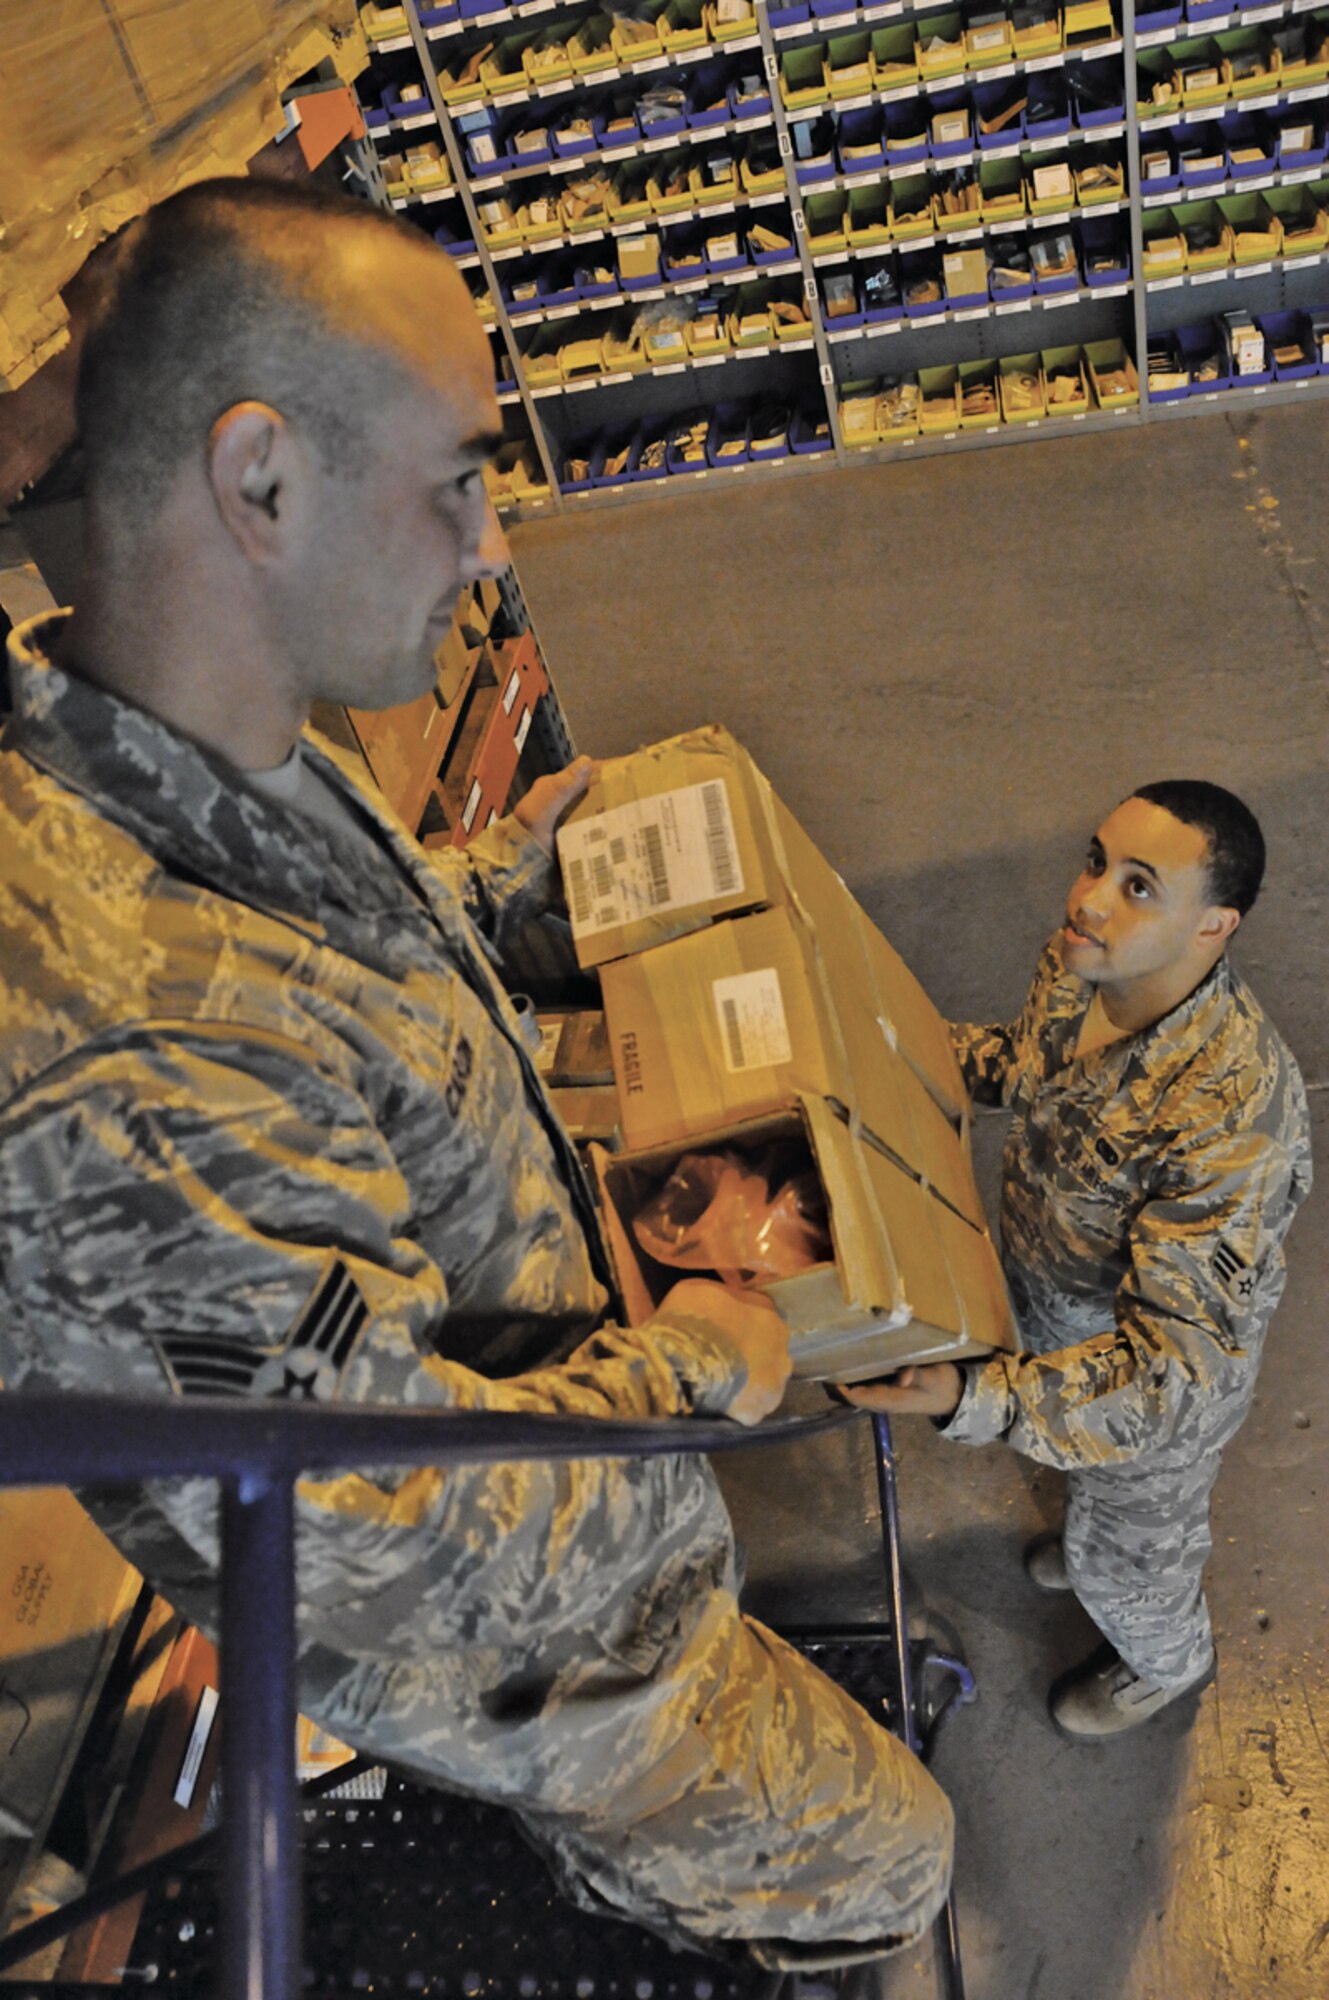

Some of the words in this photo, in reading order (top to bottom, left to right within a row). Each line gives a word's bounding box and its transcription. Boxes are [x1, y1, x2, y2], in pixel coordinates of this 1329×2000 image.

[768, 57, 776, 77] E
[780, 135, 790, 154] D
[796, 212, 804, 229] C
[807, 282, 815, 298] B
[824, 367, 831, 382] A
[620, 1032, 644, 1096] FRAGILE
[11, 1565, 29, 1597] GSA
[16, 1562, 45, 1623] GLOBAL
